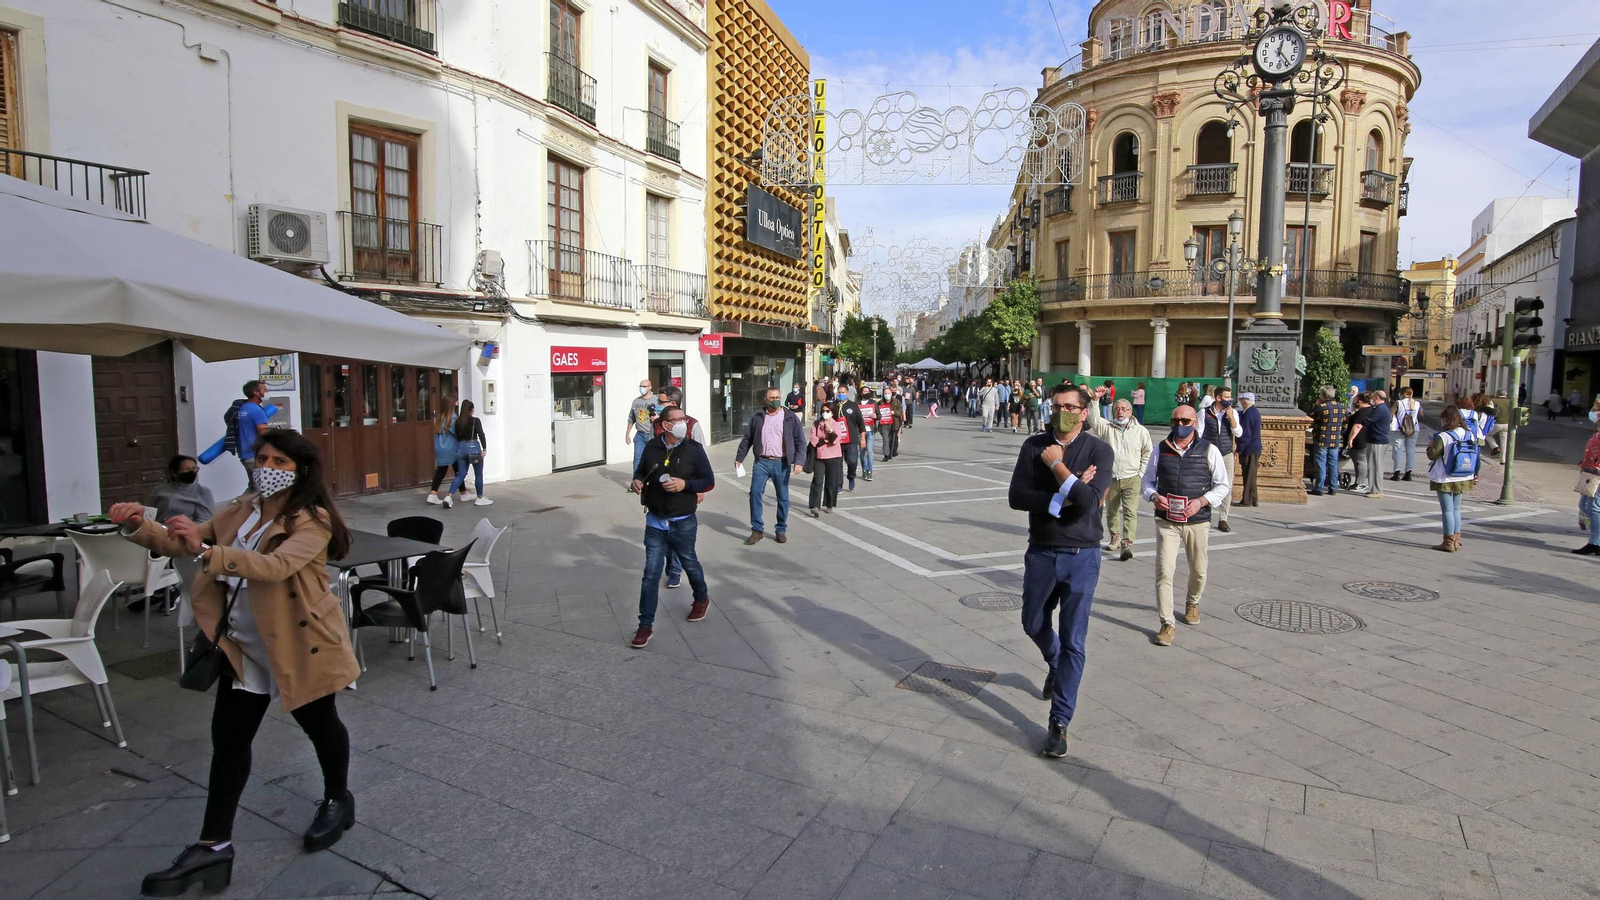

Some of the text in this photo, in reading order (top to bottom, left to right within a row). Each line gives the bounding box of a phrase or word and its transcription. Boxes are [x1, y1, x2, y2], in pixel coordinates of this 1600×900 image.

[1102, 0, 1356, 60] FUNDAOR
[813, 82, 825, 286] ULLOA OPTICO
[758, 208, 795, 240] Ulloa Optico
[552, 352, 579, 366] GAES
[1238, 384, 1291, 395] DOMECQ
[1245, 375, 1285, 383] PEDRO
